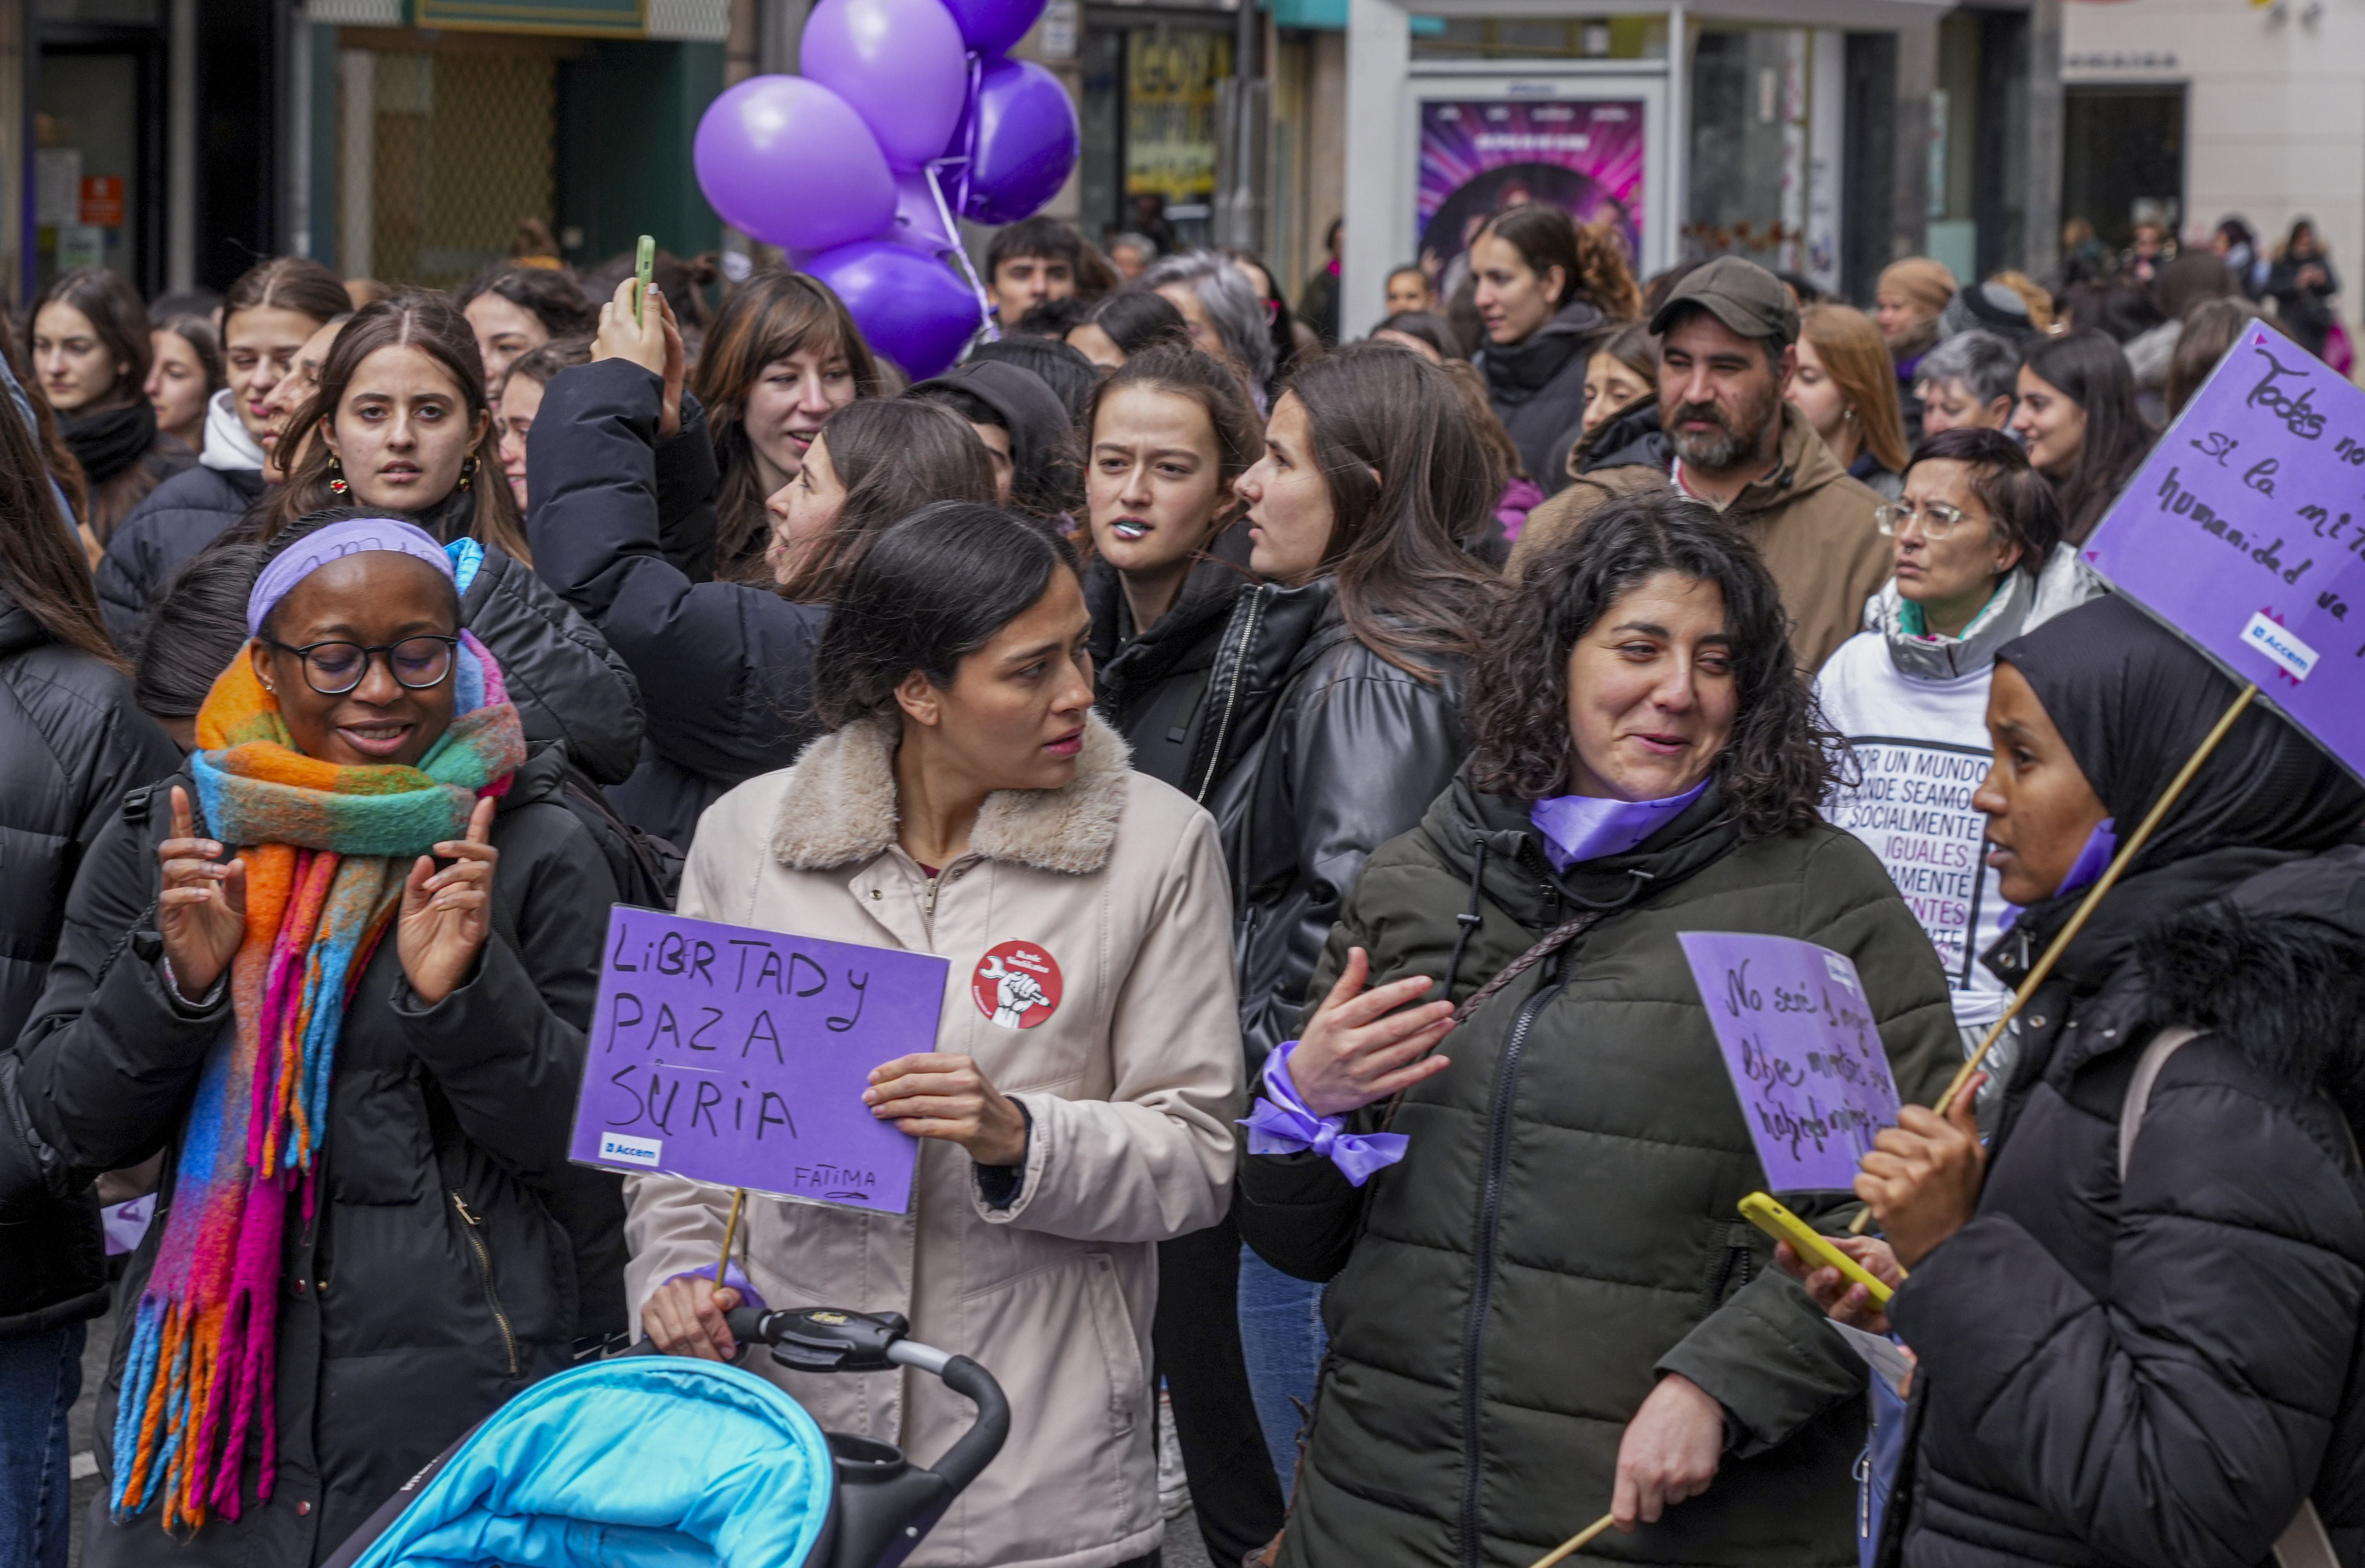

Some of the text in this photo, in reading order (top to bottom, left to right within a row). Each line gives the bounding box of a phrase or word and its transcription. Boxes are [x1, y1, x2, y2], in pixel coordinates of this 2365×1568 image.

[2157, 467, 2349, 622] humanidad va
[1885, 751, 1911, 773] UN
[1914, 754, 1988, 784] MUNDO
[1901, 779, 1970, 810] SEAMO
[1848, 805, 1981, 840] SOCIALMENTE
[1888, 865, 1971, 898] AMENTE
[1725, 958, 1762, 1017] No
[606, 992, 784, 1065] PAZ A
[615, 1144, 655, 1159] Accem
